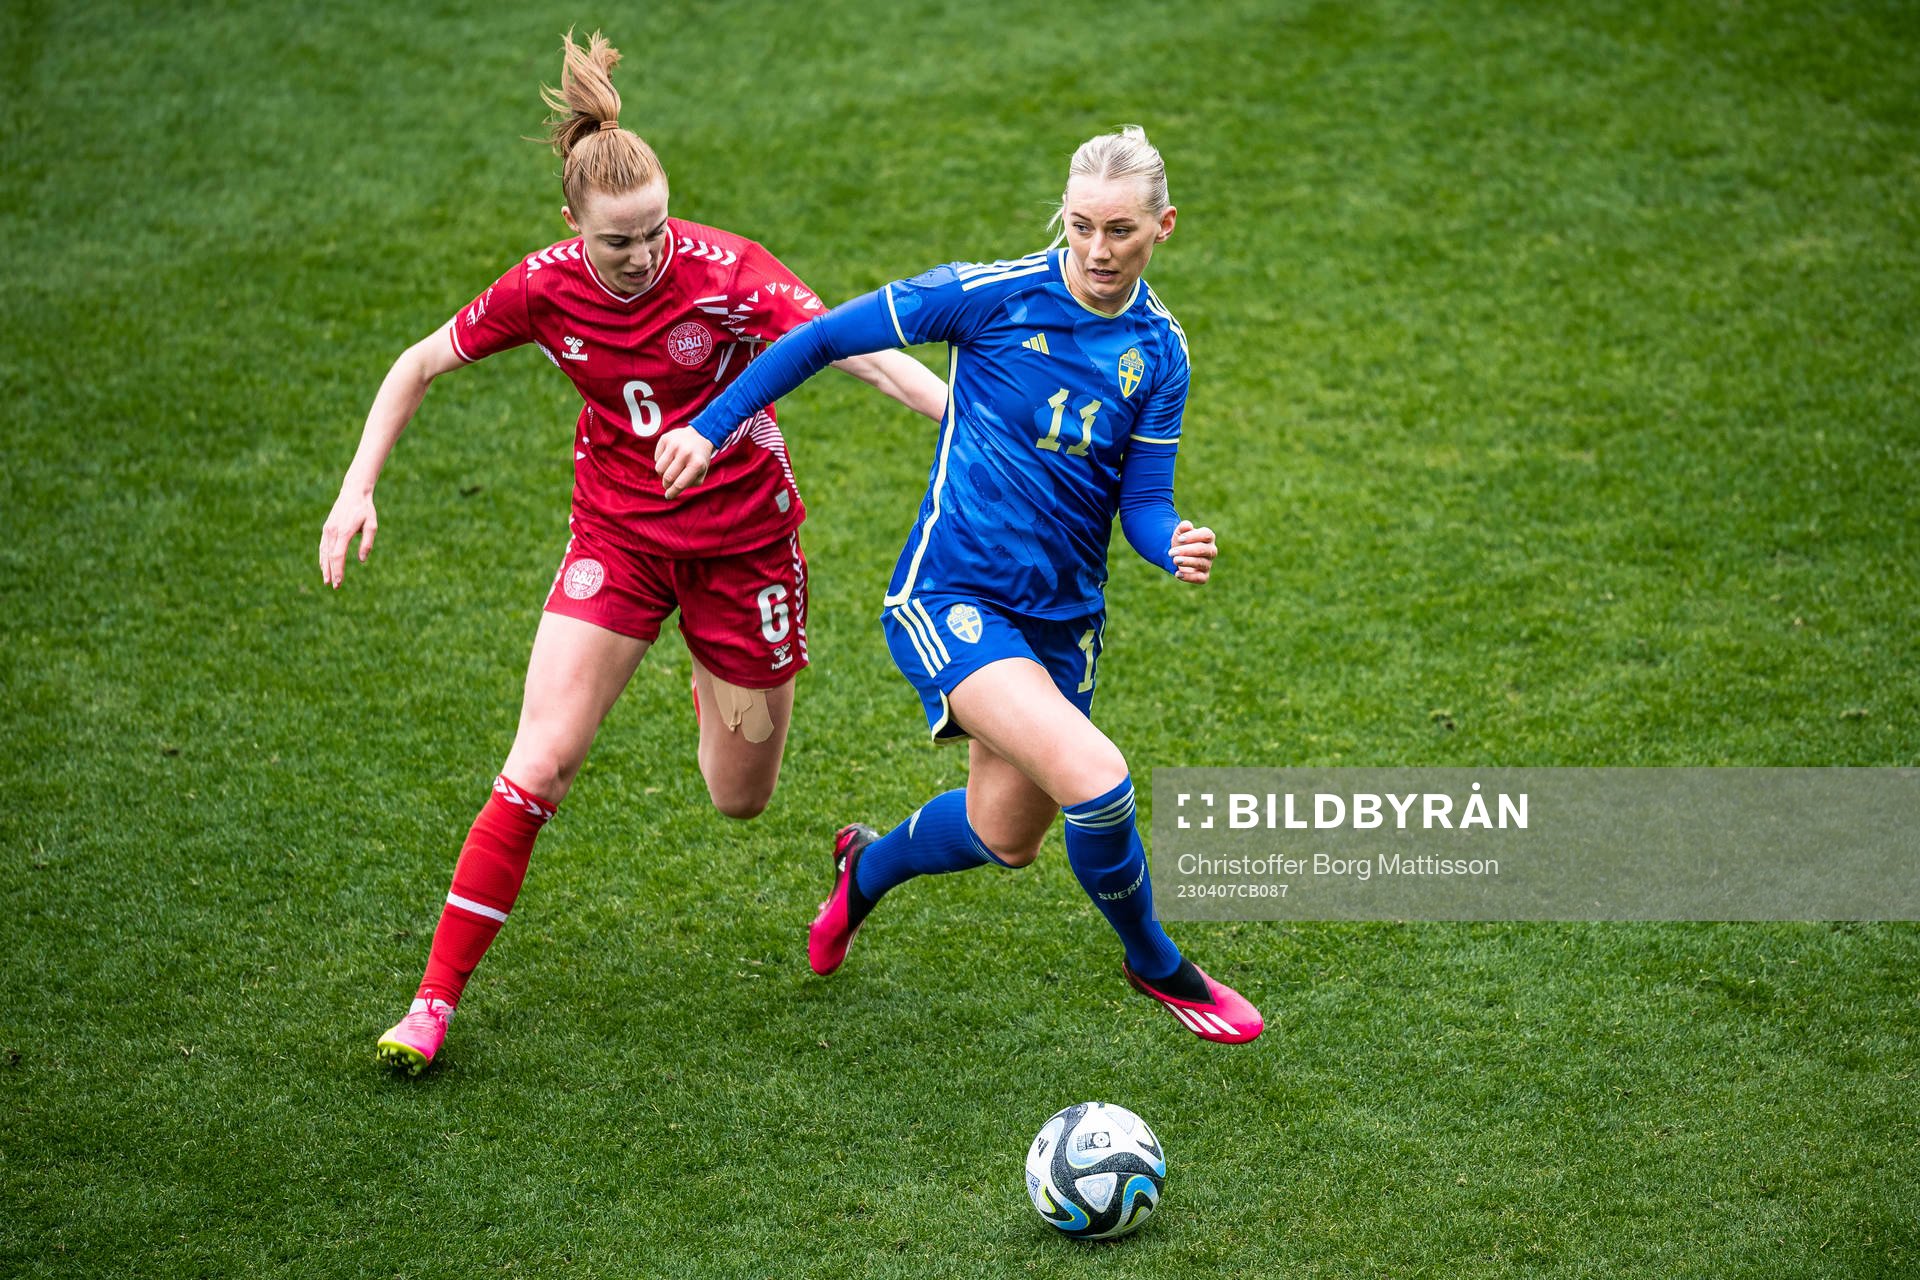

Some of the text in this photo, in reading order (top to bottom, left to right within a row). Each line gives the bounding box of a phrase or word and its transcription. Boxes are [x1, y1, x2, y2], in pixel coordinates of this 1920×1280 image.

[677, 335, 703, 352] DBU
[623, 381, 662, 437] 6
[1036, 388, 1102, 457] 11
[758, 584, 790, 643] 6
